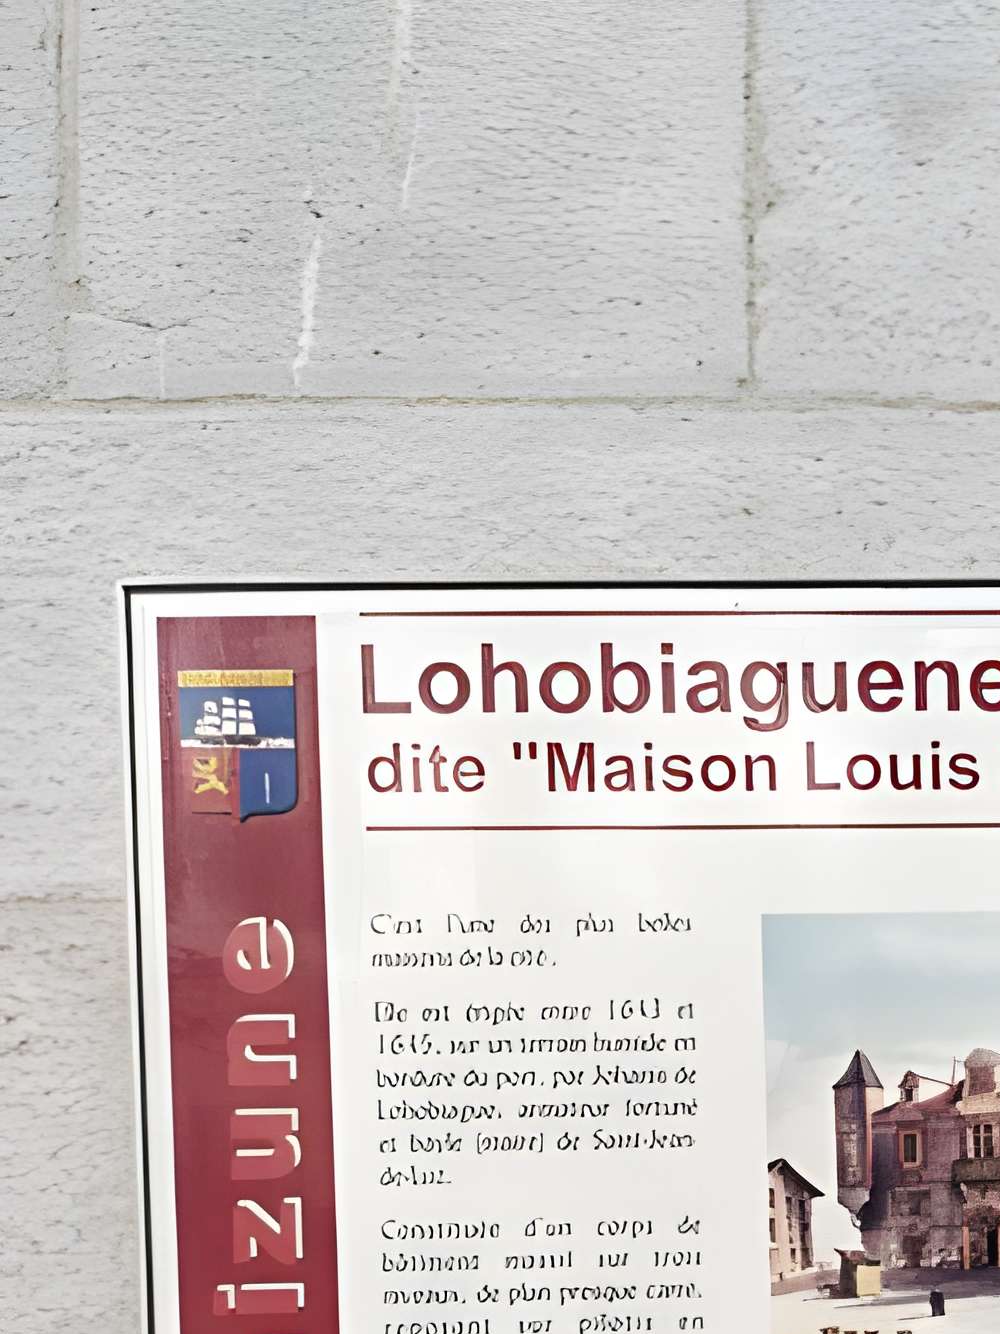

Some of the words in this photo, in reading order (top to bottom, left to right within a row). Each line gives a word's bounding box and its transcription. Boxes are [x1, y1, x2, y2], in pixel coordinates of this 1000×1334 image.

[368, 743, 486, 792] dite
[513, 742, 777, 792] "Maison
[806, 741, 980, 791] Louis
